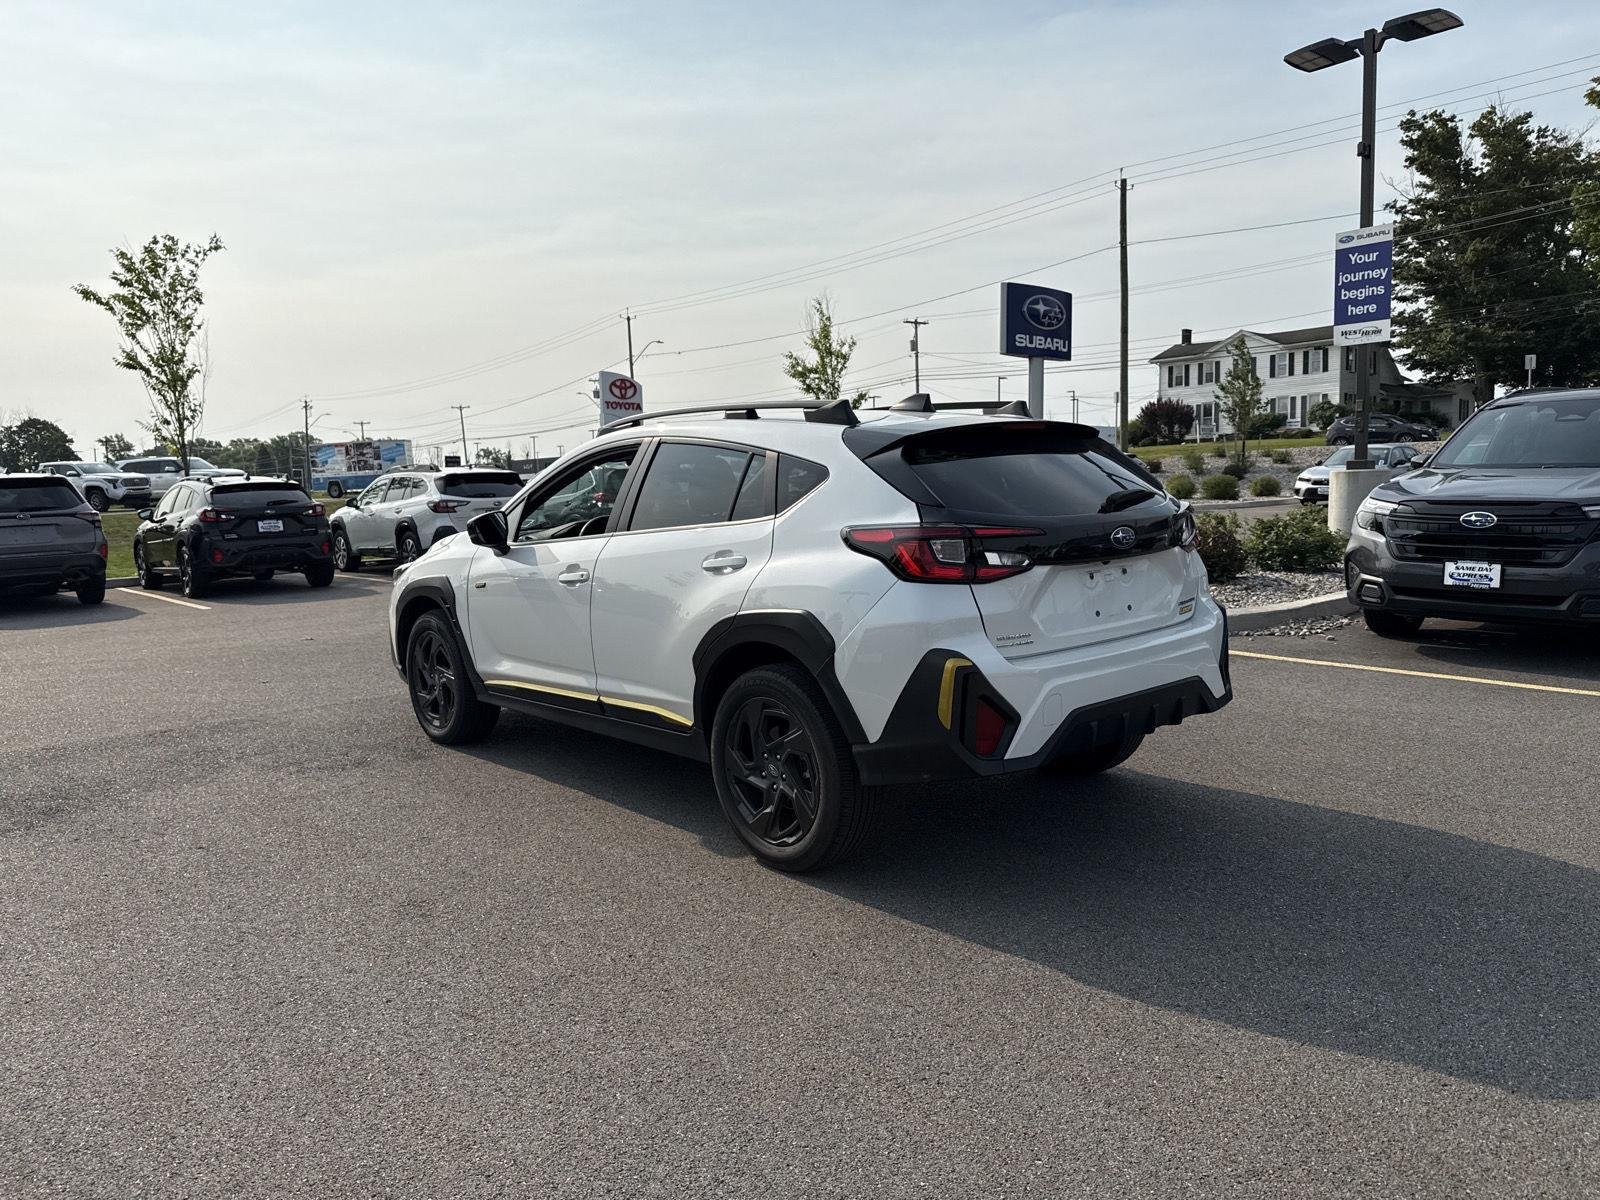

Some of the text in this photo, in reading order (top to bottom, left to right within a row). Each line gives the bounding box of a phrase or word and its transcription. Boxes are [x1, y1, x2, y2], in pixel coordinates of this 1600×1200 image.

[1356, 229, 1390, 240] SUBARU
[1348, 251, 1379, 264] Your
[1338, 267, 1388, 286] journey
[1341, 285, 1385, 300] begins
[1348, 303, 1377, 316] here
[1015, 333, 1069, 352] SUBARU
[605, 401, 642, 411] TOYOTA
